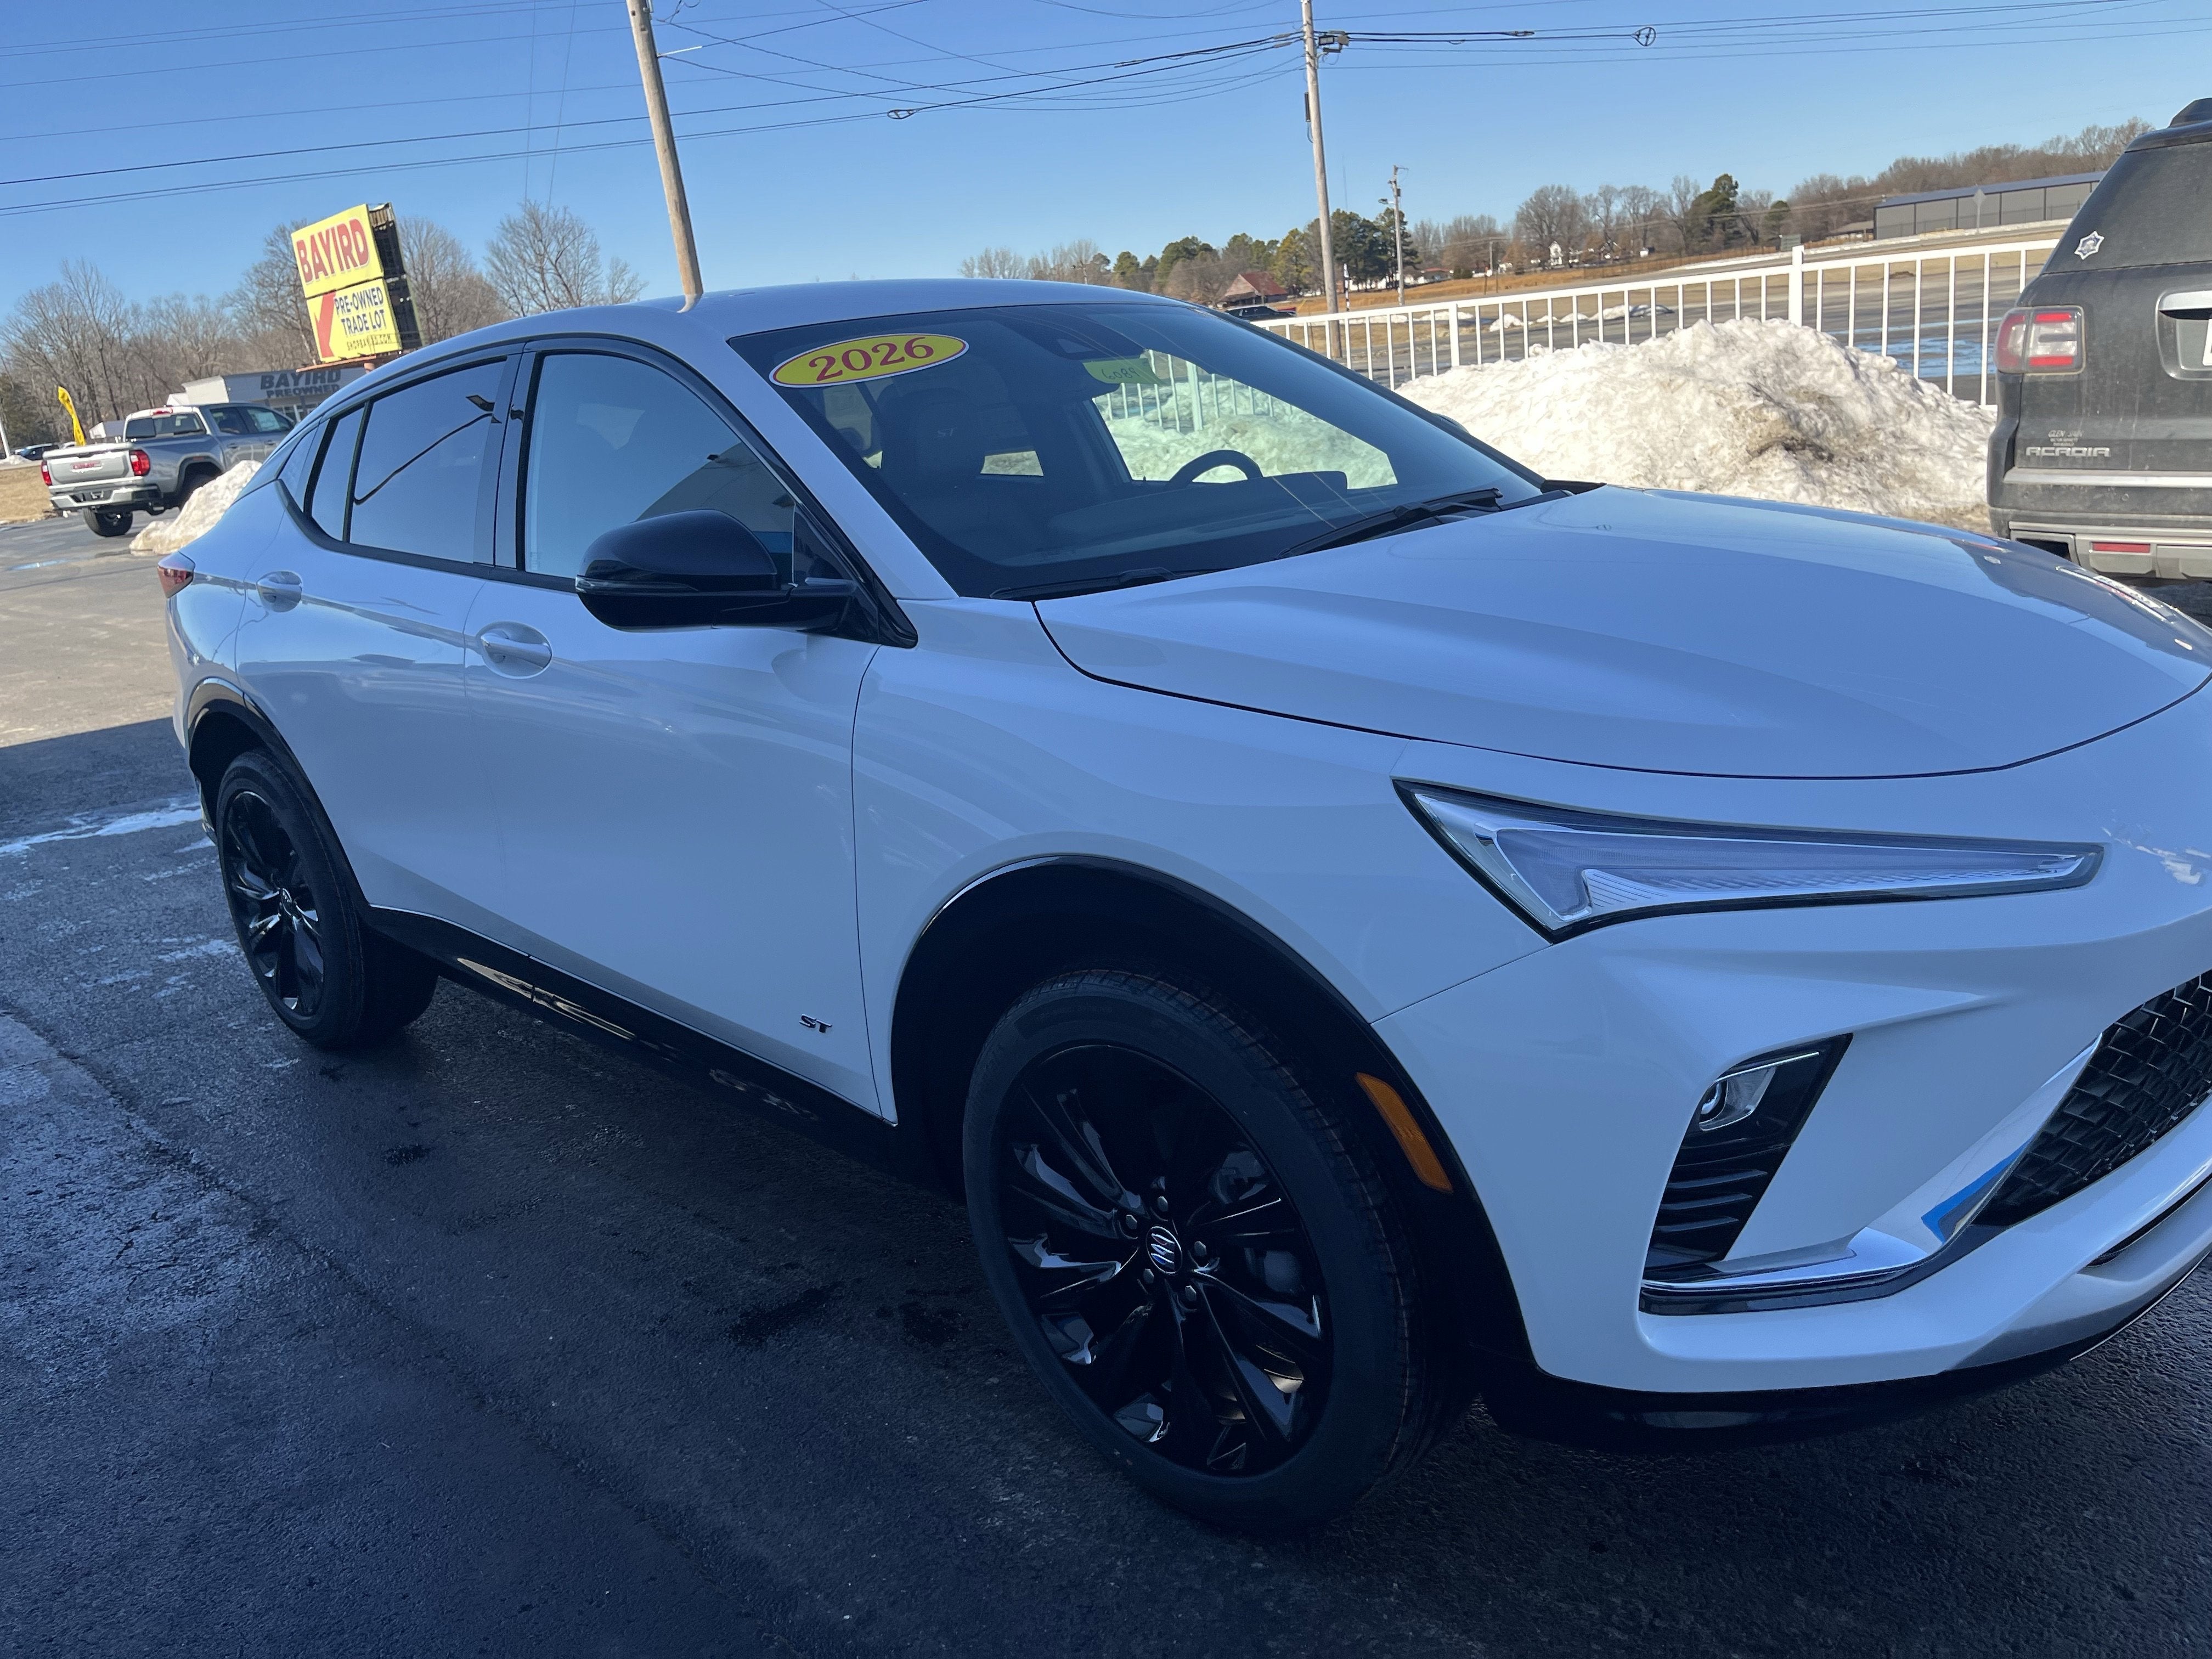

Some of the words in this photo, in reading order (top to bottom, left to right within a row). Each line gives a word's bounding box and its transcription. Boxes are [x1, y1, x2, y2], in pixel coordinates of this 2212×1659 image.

[296, 218, 370, 284] BAYIRD
[334, 286, 384, 315] PRE-OWNED
[341, 313, 370, 336] TRADE
[369, 309, 387, 330] LOT
[809, 337, 934, 381] 2026
[261, 370, 341, 390] BAYIRD
[1101, 367, 1140, 380] 6089
[267, 384, 340, 398] PREOWNED
[2026, 447, 2111, 457] ACADIA
[799, 1014, 832, 1033] ST
